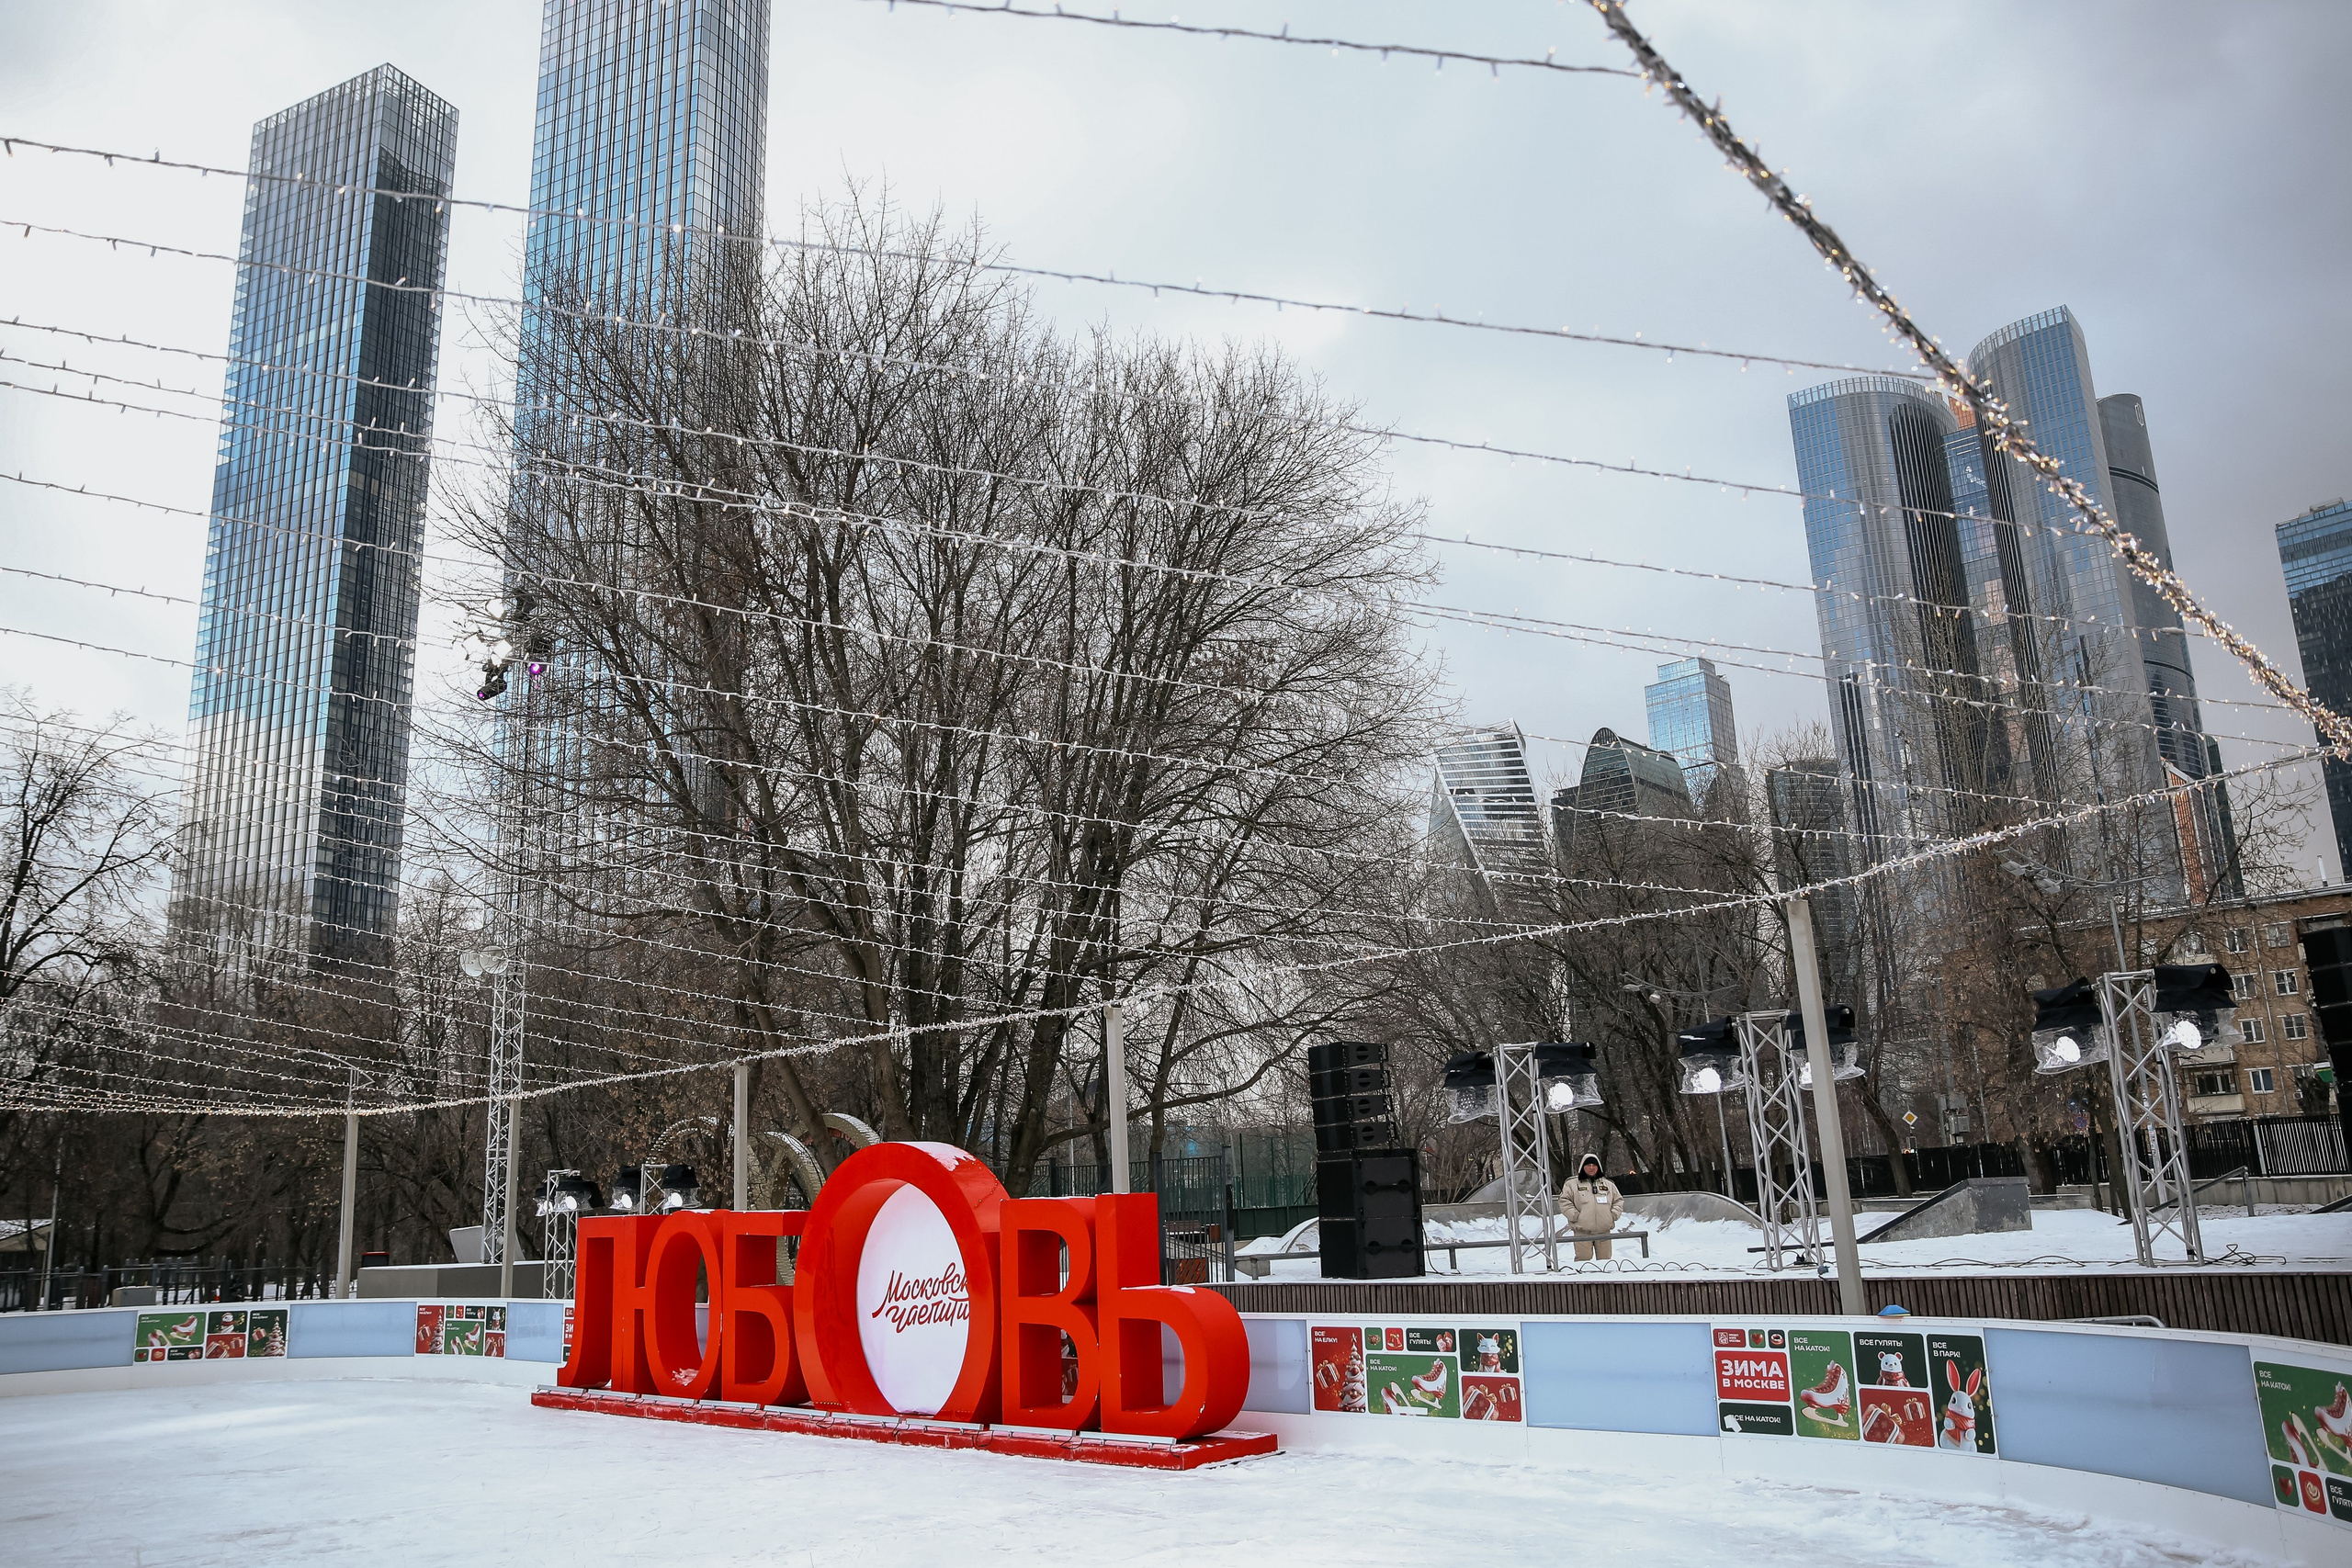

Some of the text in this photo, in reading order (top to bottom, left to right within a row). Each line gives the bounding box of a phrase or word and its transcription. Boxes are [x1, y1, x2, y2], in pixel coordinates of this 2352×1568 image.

[558, 1142, 1250, 1439] ЛЮБОВЬ
[1721, 1359, 1784, 1378] ЗИМА
[2259, 1370, 2272, 1378] ВСЕ
[1722, 1378, 1785, 1390] В МОСКВЕ
[2261, 1380, 2270, 1388] НА
[2329, 1484, 2343, 1495] ВСЕ
[2332, 1495, 2352, 1508] ГУЛЯТ
